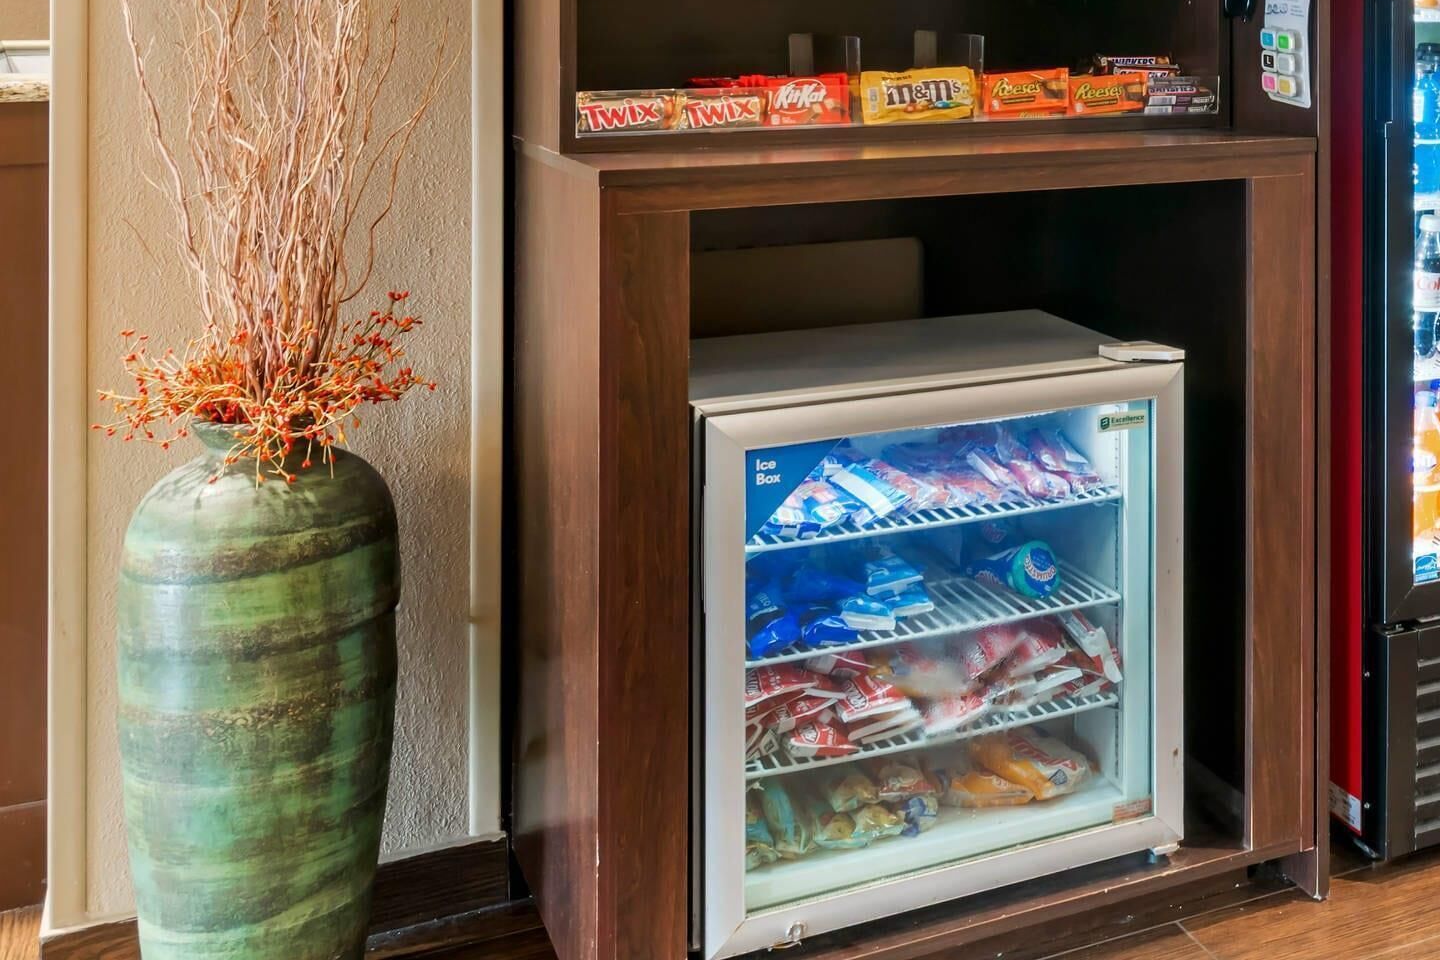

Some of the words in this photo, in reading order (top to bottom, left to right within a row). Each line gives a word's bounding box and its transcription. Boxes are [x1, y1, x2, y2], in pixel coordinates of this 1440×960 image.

[992, 78, 1041, 97] Reese's
[1075, 82, 1122, 101] Reese's
[755, 458, 777, 472] Ice
[755, 472, 781, 486] Box
